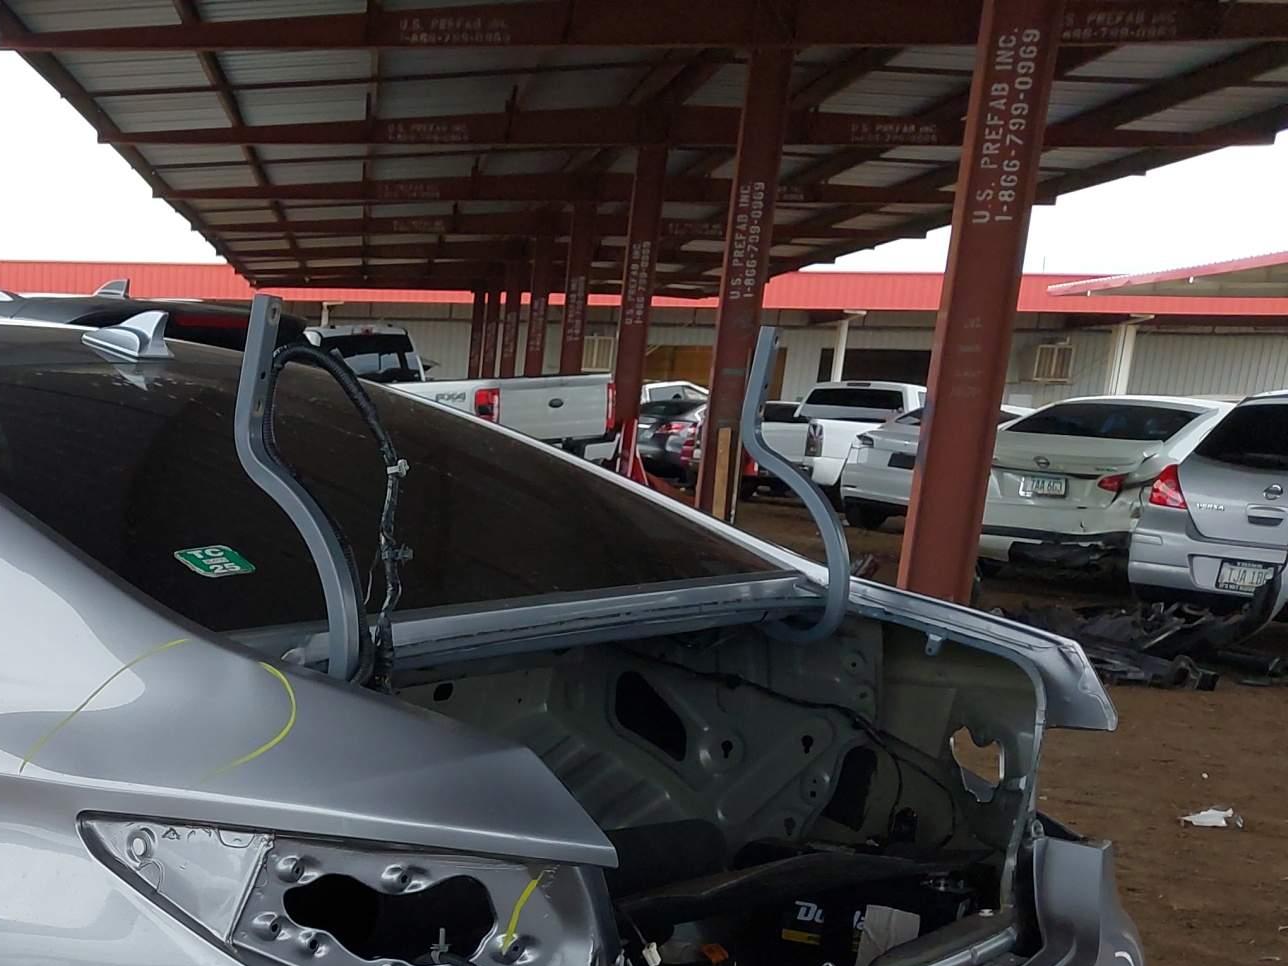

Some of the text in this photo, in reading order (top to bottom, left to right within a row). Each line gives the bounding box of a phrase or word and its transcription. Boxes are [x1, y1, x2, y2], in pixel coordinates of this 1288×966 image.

[995, 28, 1019, 71] INC.
[981, 83, 1010, 169] PREFAB
[995, 28, 1041, 223] 1-866-799-0969
[732, 213, 749, 267] PREFAB
[186, 548, 224, 559] TC
[209, 563, 240, 574] 25
